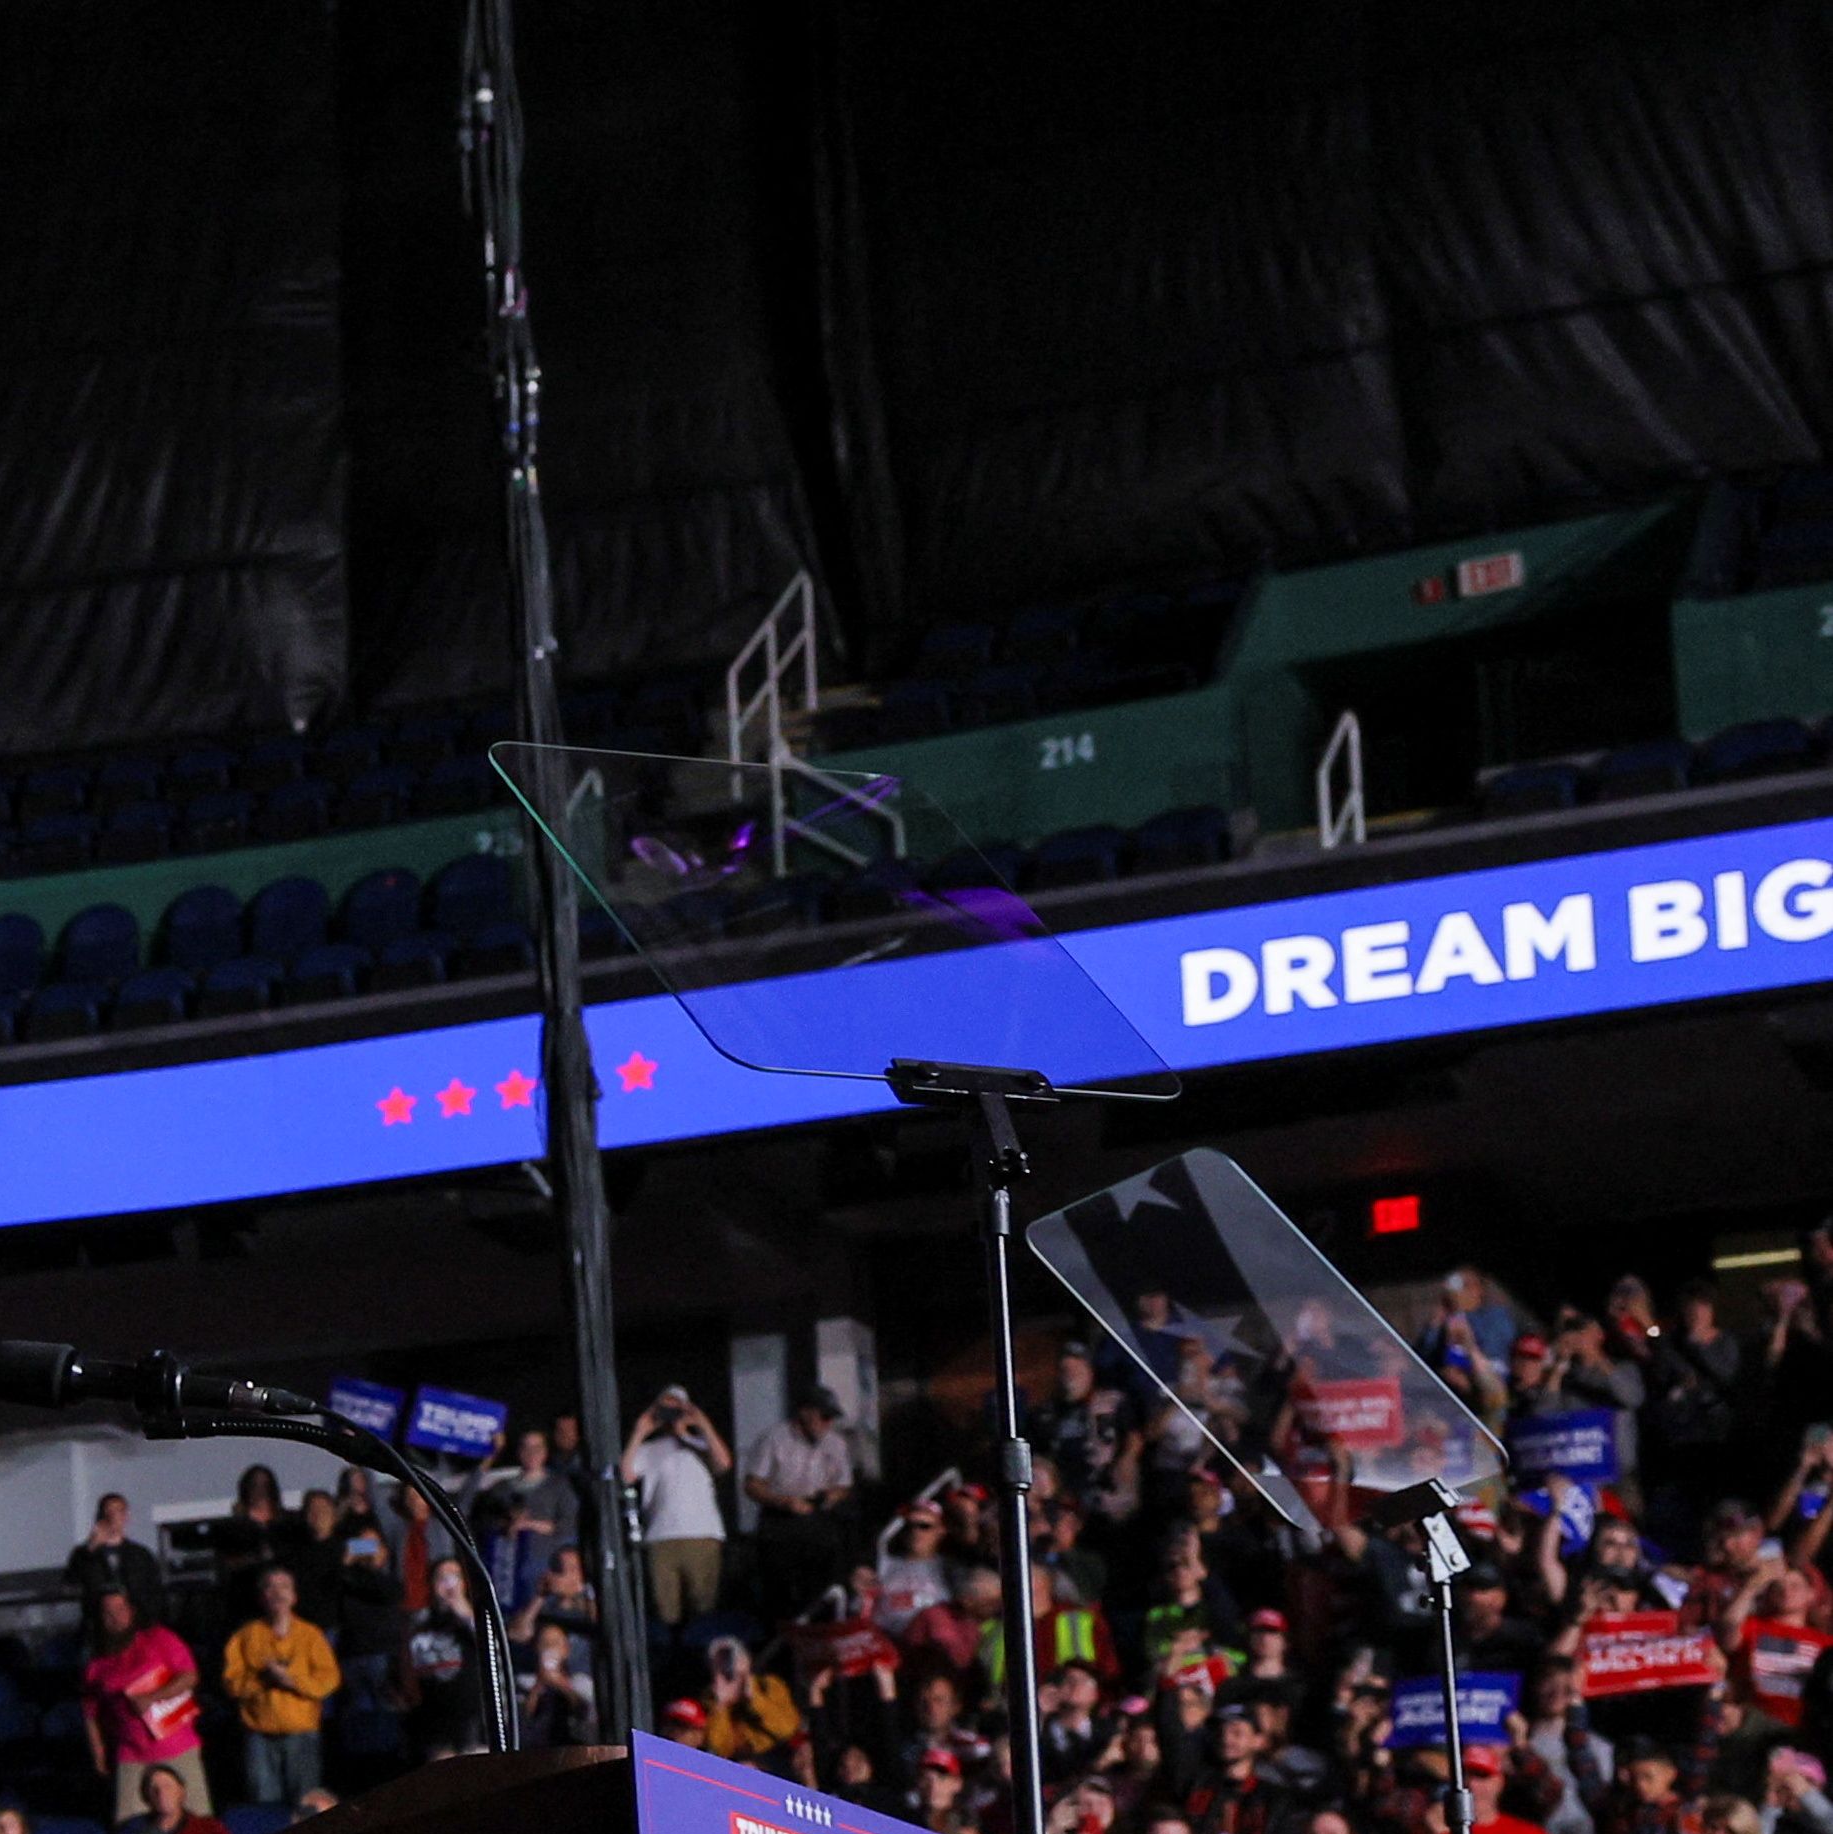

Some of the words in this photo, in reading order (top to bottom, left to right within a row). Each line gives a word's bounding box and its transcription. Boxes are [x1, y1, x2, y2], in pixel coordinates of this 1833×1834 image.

[1040, 732, 1095, 769] 214
[1181, 892, 1597, 1027] DREAM
[1628, 858, 1833, 963] BIG
